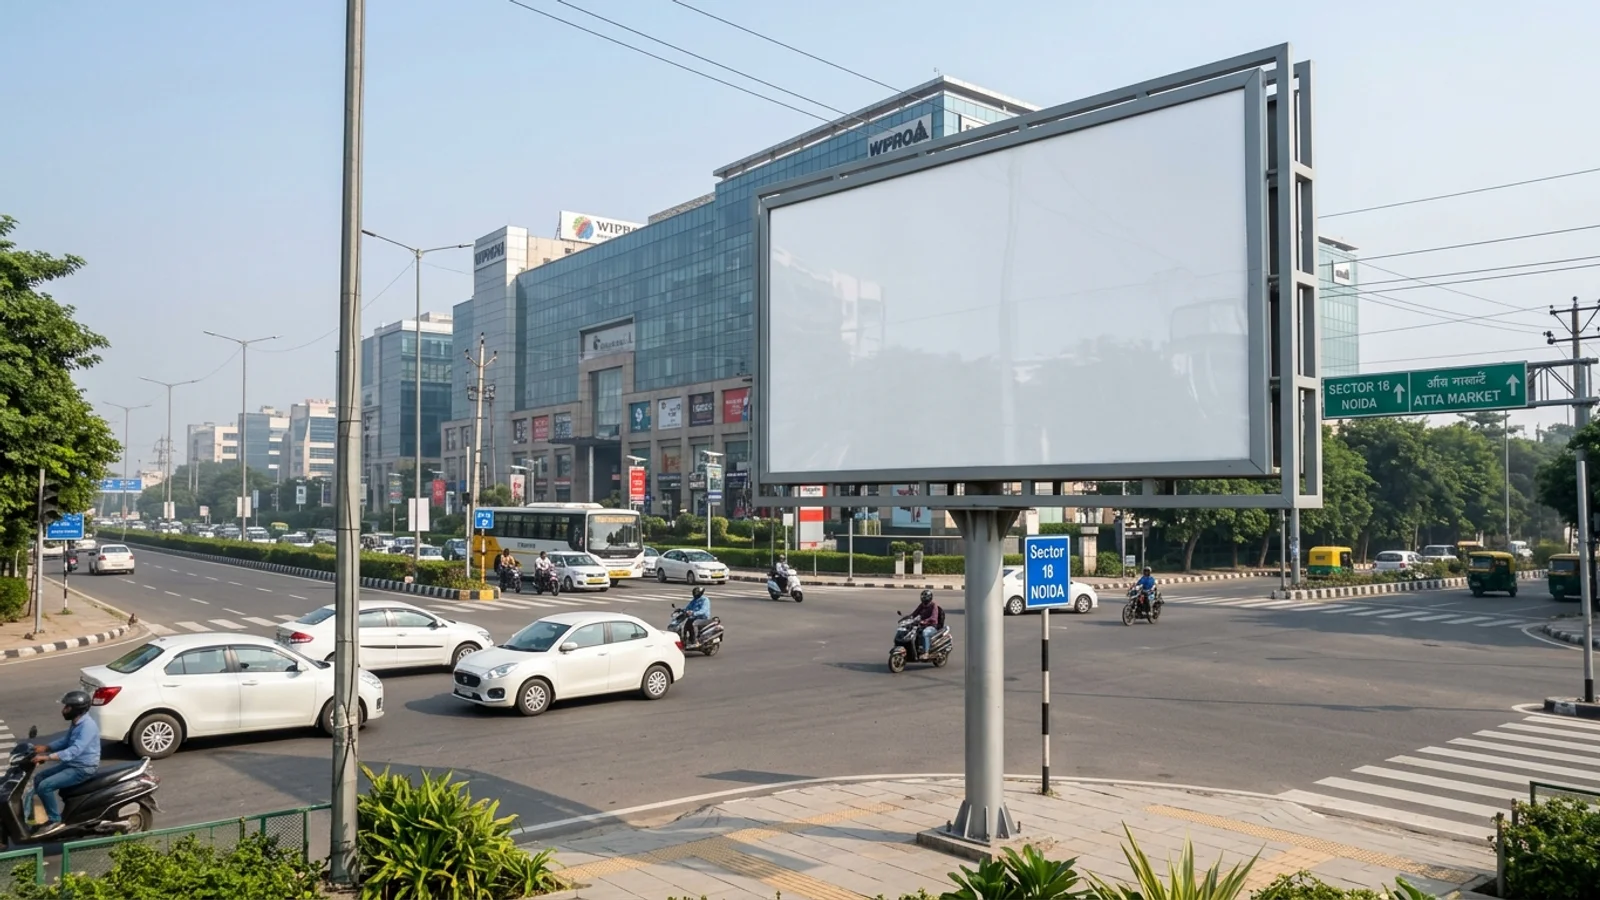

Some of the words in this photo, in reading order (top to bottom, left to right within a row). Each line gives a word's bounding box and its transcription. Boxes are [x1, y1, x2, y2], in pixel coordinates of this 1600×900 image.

[1329, 381, 1374, 395] SECTOR
[1377, 380, 1390, 391] 18
[1341, 397, 1377, 410] NOIDA
[1413, 394, 1445, 406] ATTA
[1447, 390, 1501, 404] MARKET
[1030, 544, 1065, 559] Sector
[1042, 564, 1054, 579] 18
[1031, 584, 1065, 599] NOIDA
